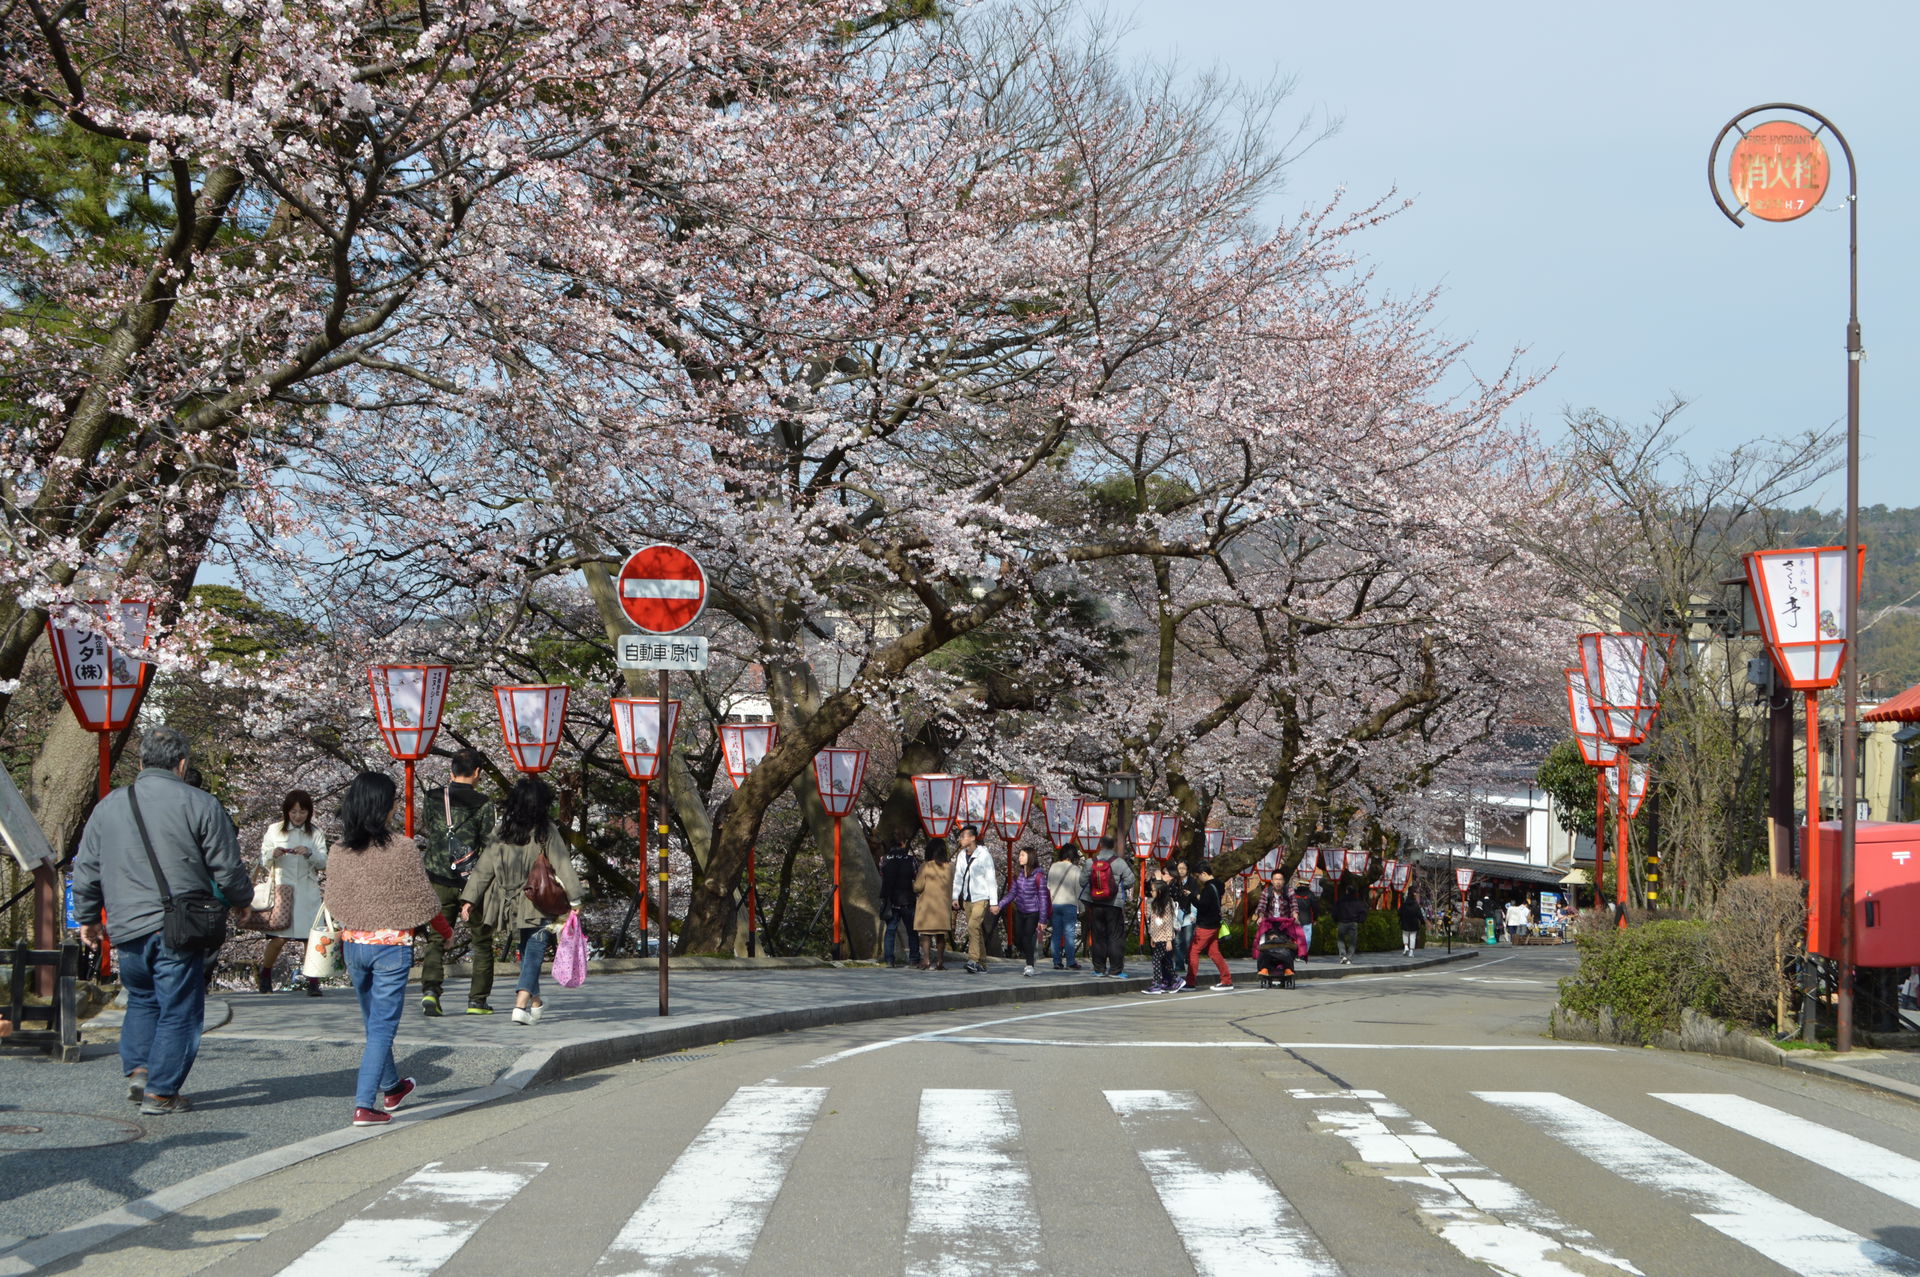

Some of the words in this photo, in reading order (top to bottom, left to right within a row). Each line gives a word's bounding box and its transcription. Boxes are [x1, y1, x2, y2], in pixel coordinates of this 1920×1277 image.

[1769, 135, 1811, 145] HYDRANT
[1740, 152, 1820, 189] 消火栓
